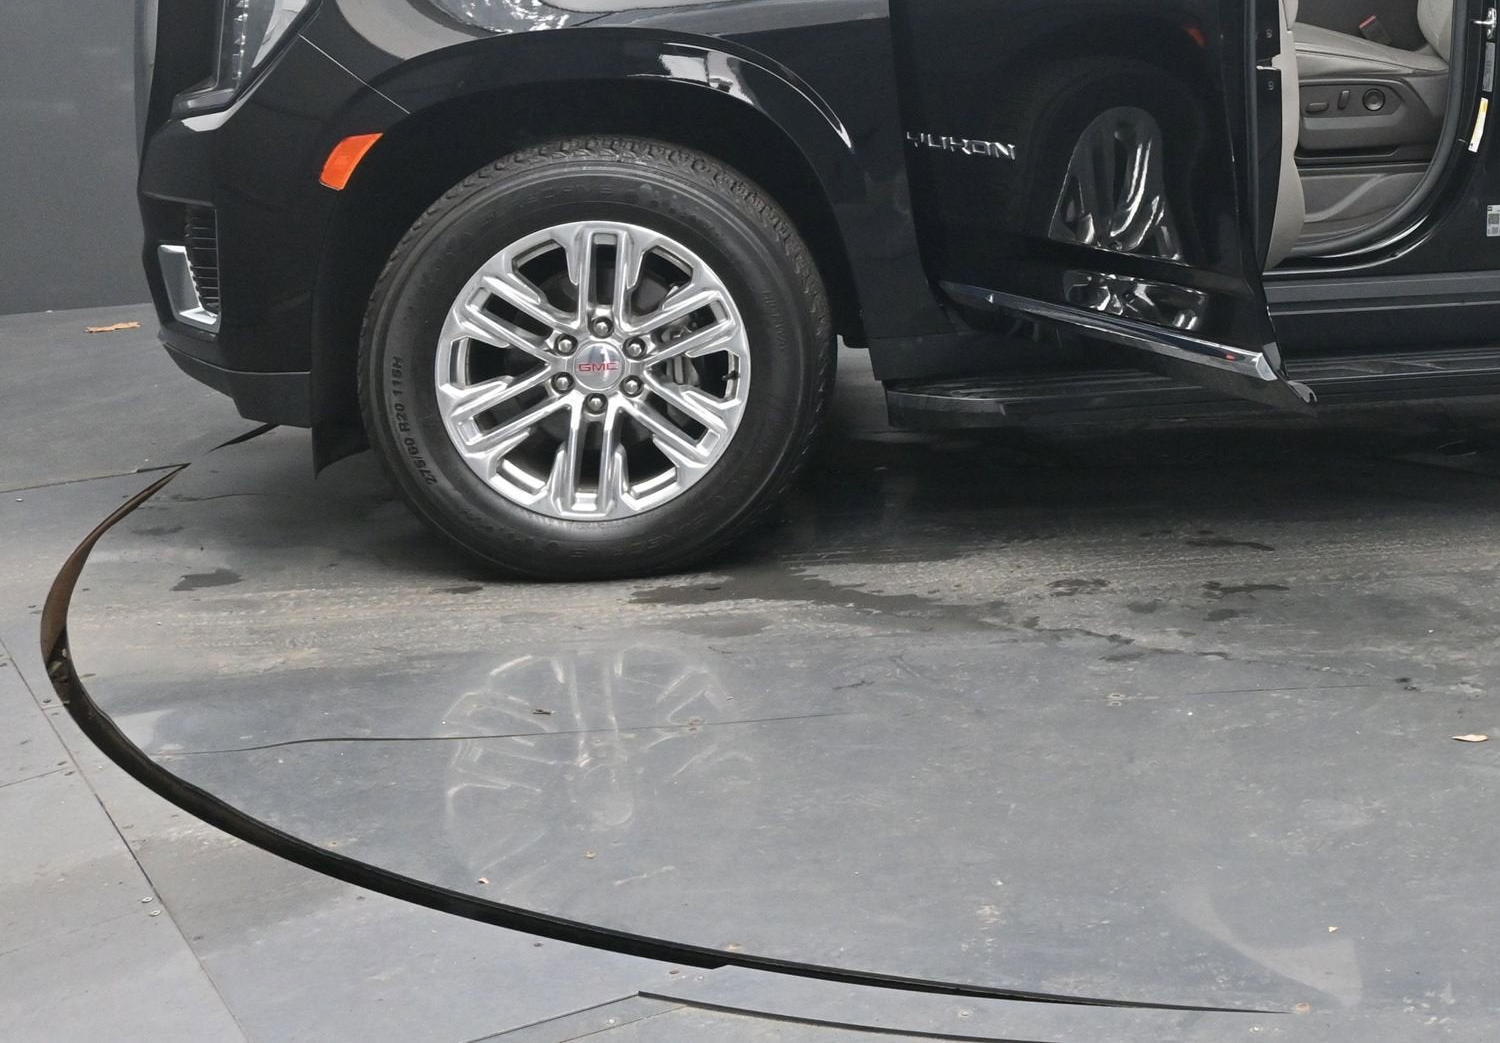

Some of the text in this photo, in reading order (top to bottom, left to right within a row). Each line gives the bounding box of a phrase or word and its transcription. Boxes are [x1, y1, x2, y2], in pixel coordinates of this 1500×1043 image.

[905, 130, 1016, 161] YUKON
[578, 362, 619, 373] GMC
[394, 403, 411, 433] R20
[404, 436, 438, 485] 275/60
